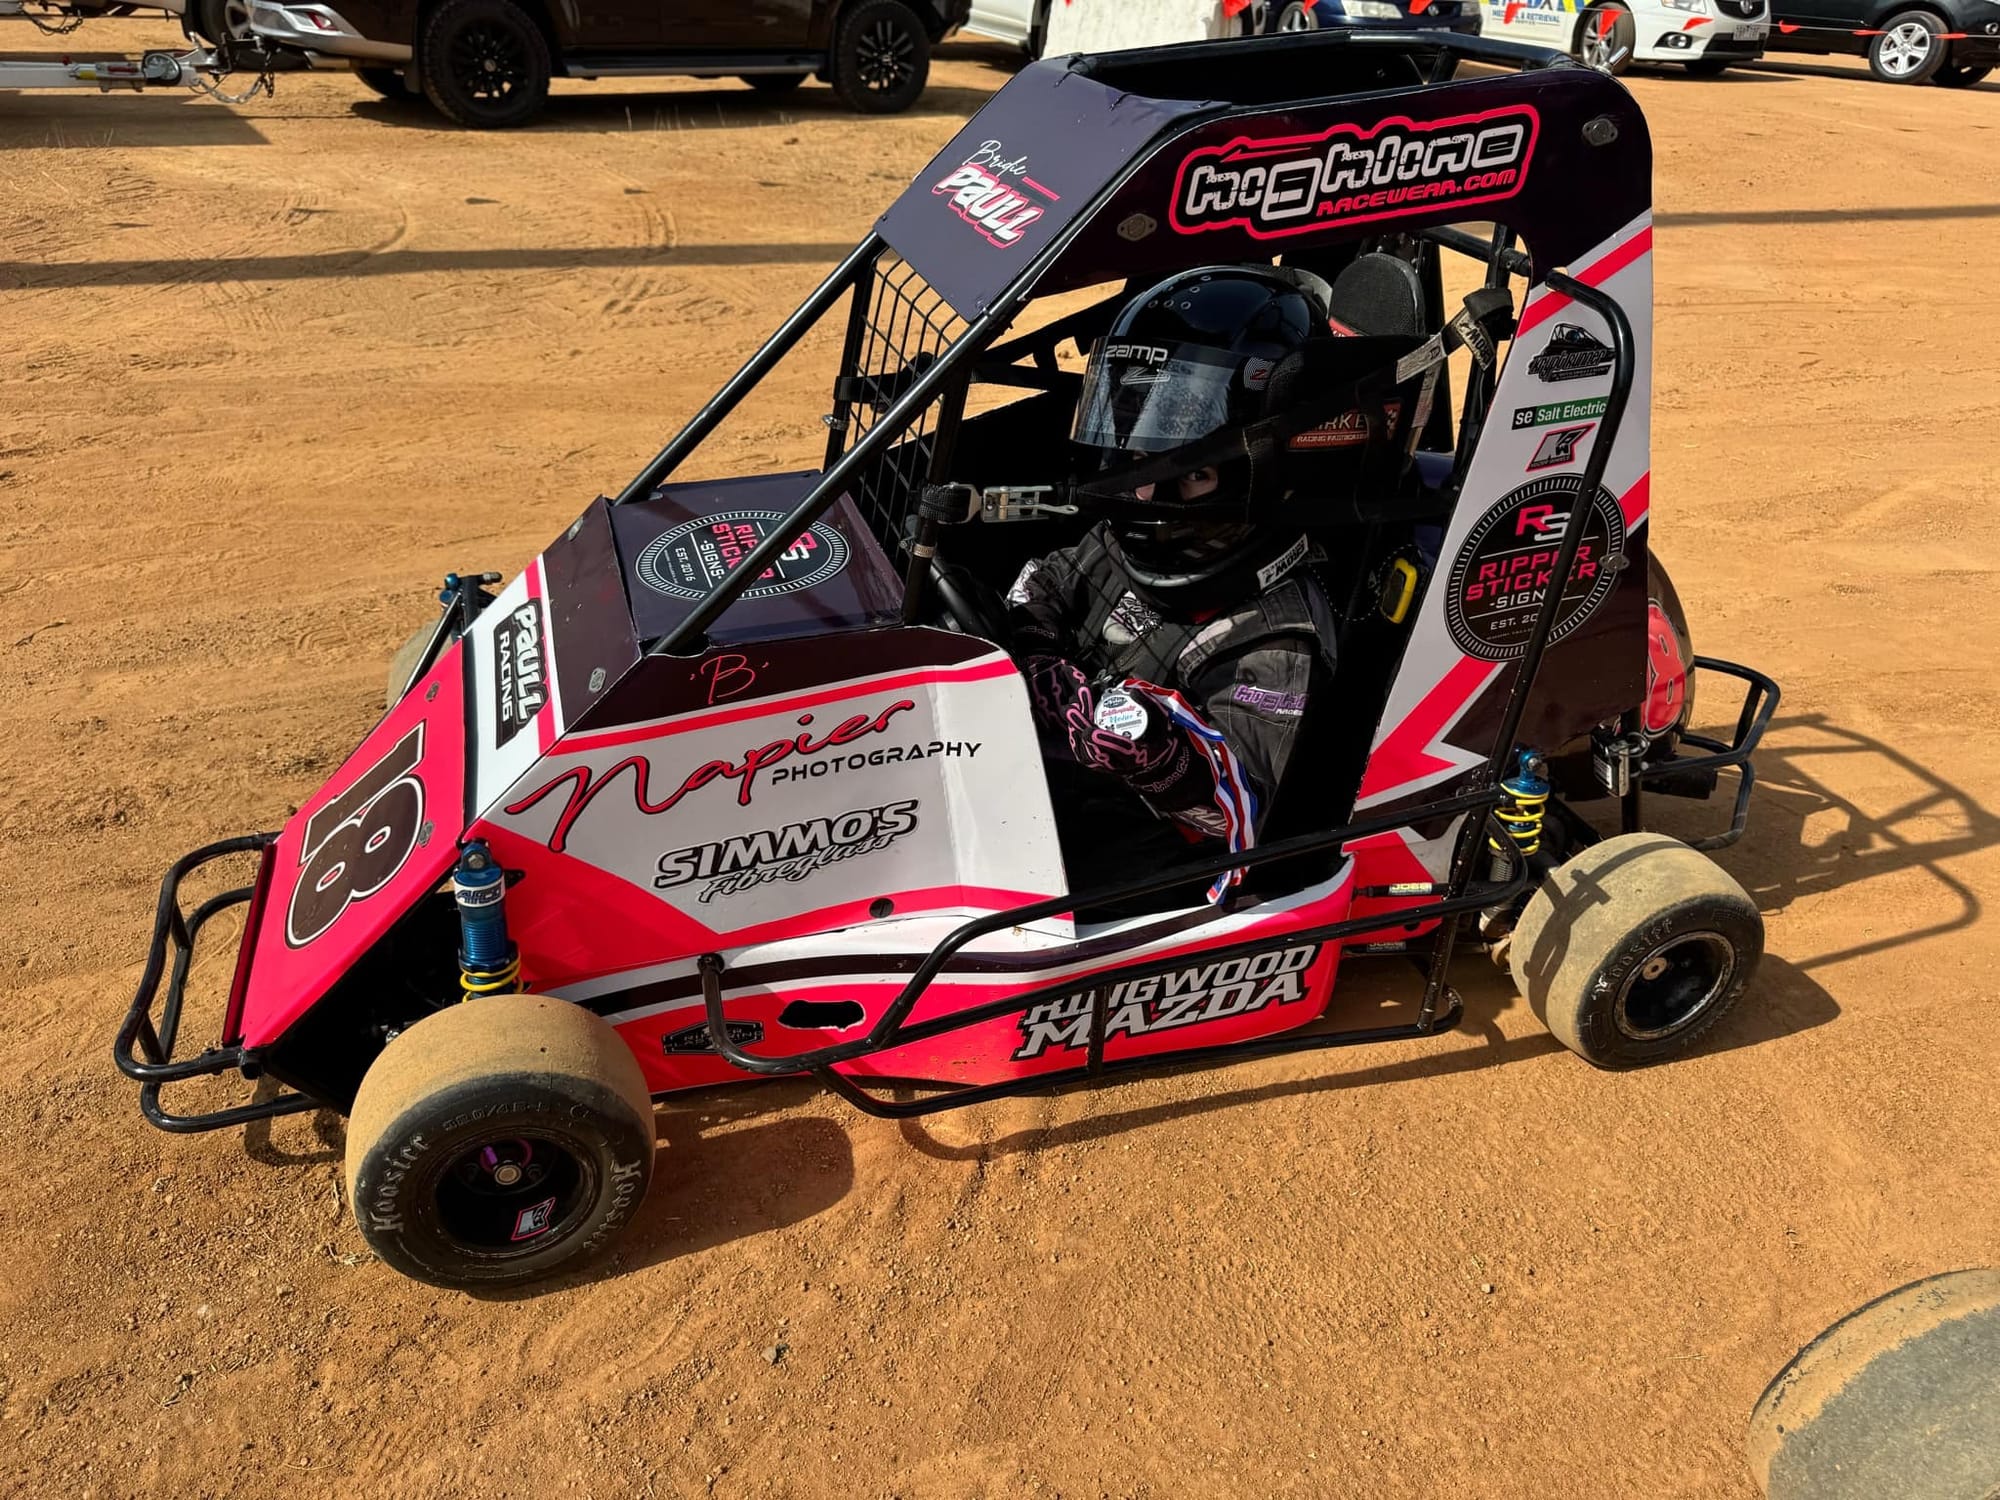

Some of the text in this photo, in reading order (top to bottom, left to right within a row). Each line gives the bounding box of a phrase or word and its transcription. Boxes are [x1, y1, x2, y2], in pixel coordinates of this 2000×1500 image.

[1105, 344, 1168, 365] zamp
[1515, 400, 1606, 426] se Salt Electric
[681, 563, 697, 582] 2016
[1465, 562, 1598, 601] STICKR
[1490, 613, 1539, 630] EST. 20
[499, 630, 513, 722] RACING
[504, 700, 915, 853] Napier
[771, 740, 982, 786] PHOTOGRAPHY
[285, 719, 427, 950] 18
[655, 799, 919, 889] SIMMO'S
[699, 833, 895, 903] Fibreglass
[1012, 970, 1304, 1060] MAZDA
